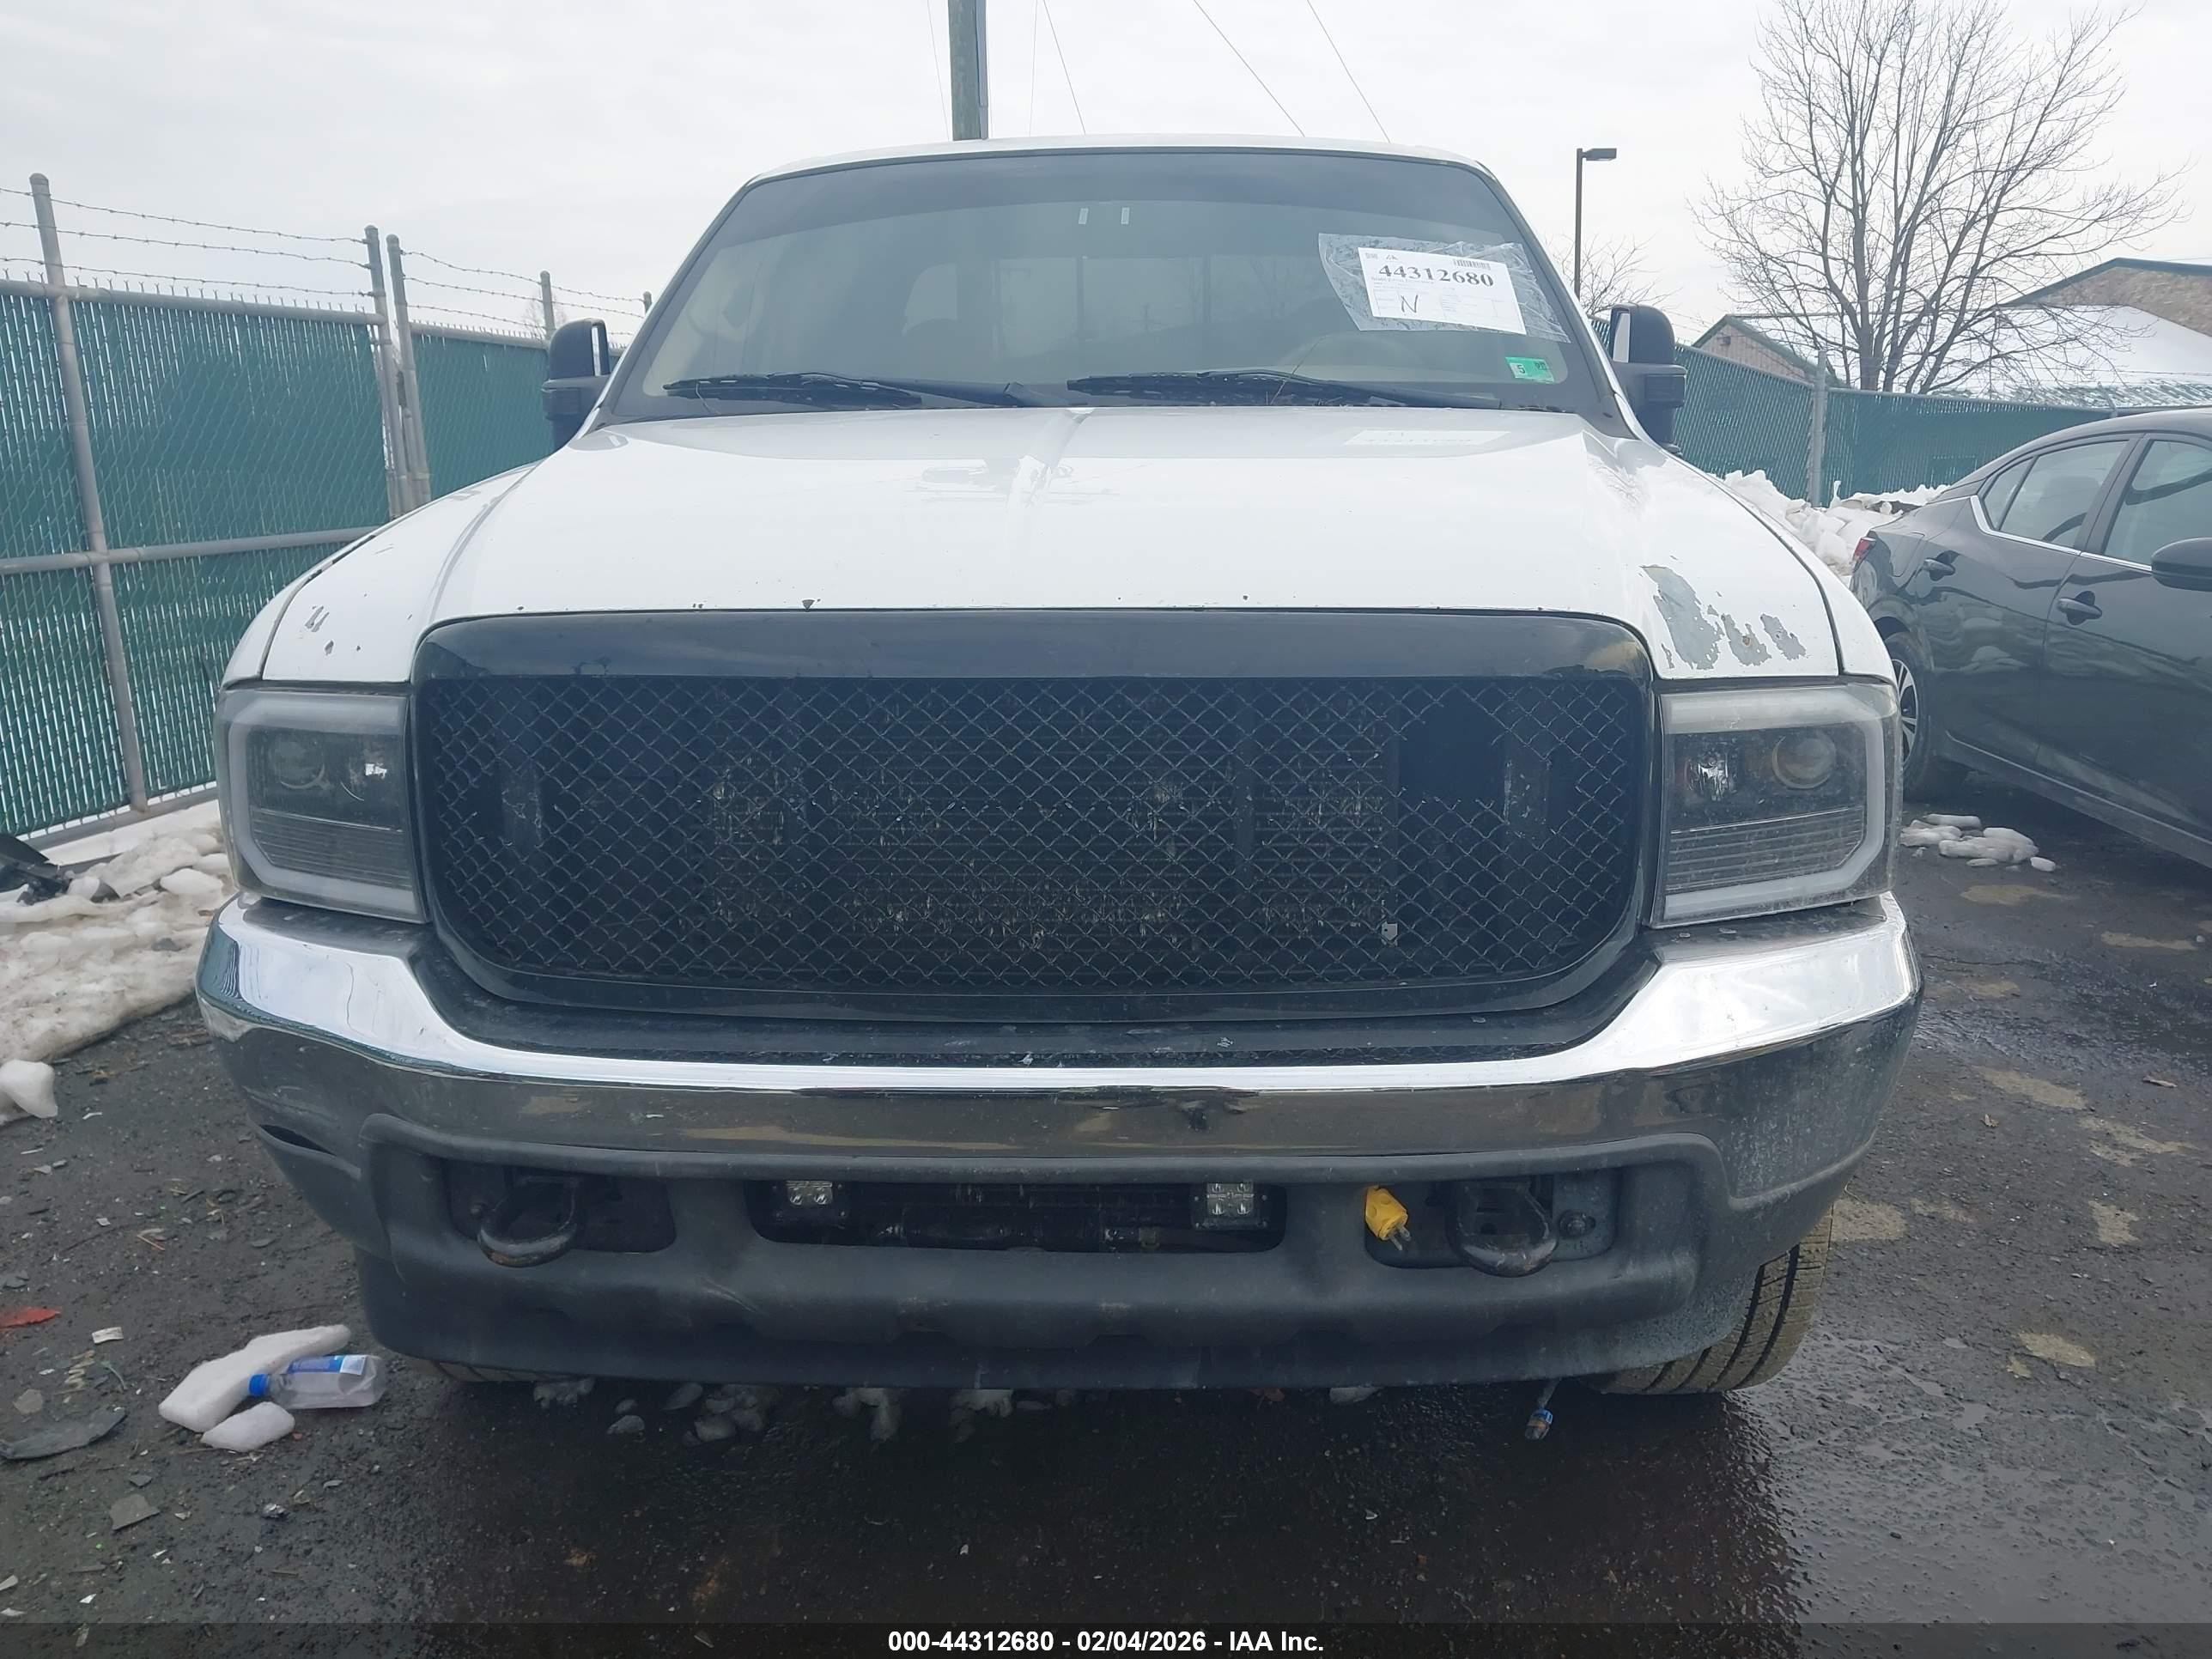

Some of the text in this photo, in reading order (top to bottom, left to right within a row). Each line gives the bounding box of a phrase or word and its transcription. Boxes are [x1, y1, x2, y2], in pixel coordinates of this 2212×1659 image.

[1378, 264, 1494, 287] 44312680
[1401, 295, 1419, 313] N
[1516, 364, 1526, 374] 5
